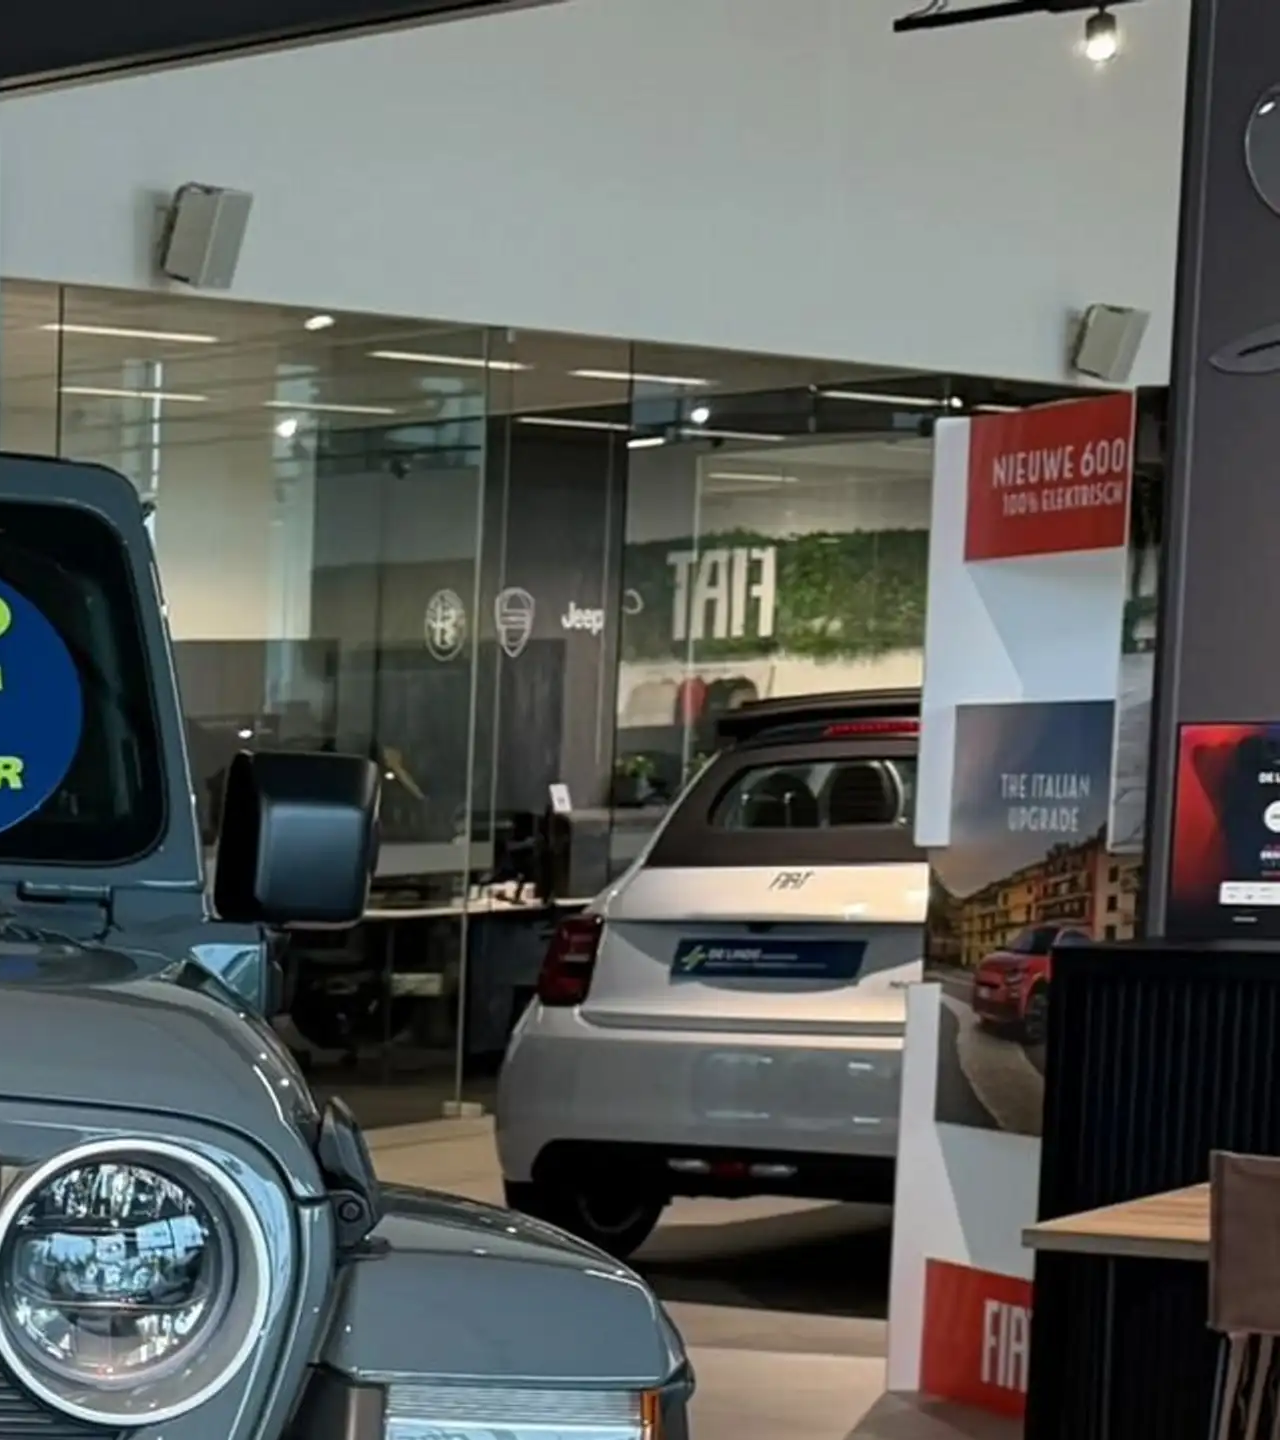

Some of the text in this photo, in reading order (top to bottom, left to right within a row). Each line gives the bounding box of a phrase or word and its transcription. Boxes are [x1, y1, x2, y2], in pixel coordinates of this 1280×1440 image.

[992, 437, 1126, 489] NIEUWE 600
[1002, 490, 1040, 517] 100%
[561, 601, 605, 636] Jeep
[1001, 772, 1090, 799] THE ITALIAN
[1008, 806, 1079, 833] UPGRADE
[981, 1298, 1033, 1393] FIA
